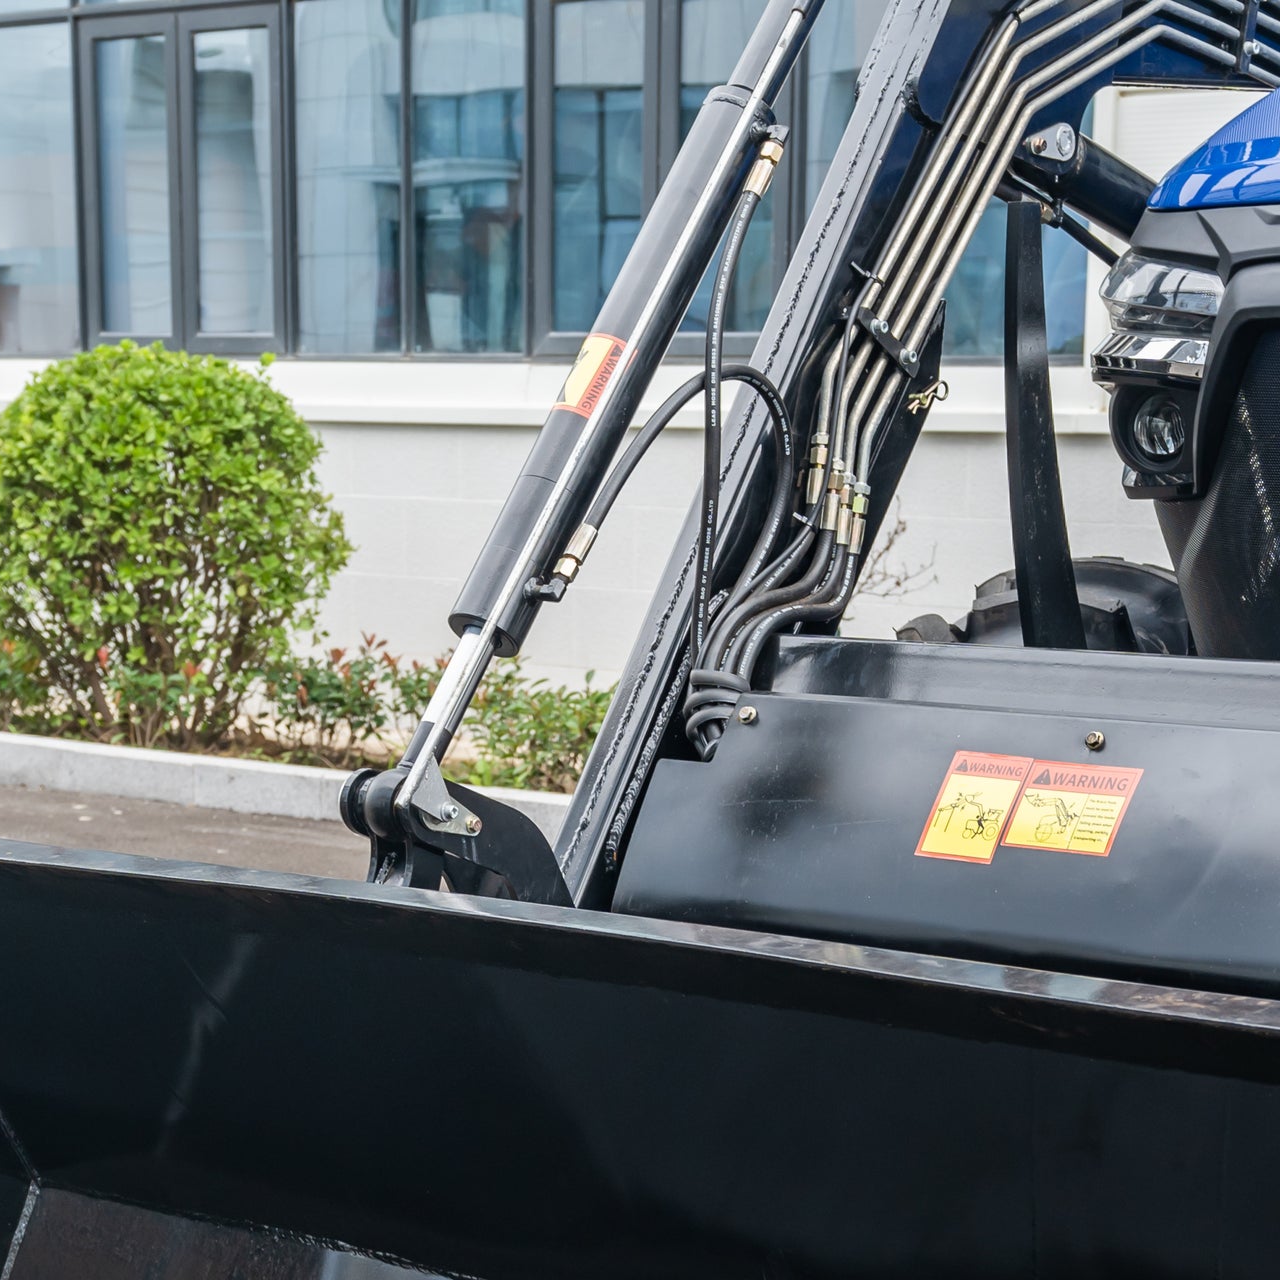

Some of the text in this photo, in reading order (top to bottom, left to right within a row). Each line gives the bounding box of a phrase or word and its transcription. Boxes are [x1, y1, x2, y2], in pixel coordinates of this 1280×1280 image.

[581, 358, 618, 411] WARNING
[705, 527, 713, 544] HOSE
[969, 761, 1024, 778] WARNING
[1052, 771, 1129, 792] WARNING
